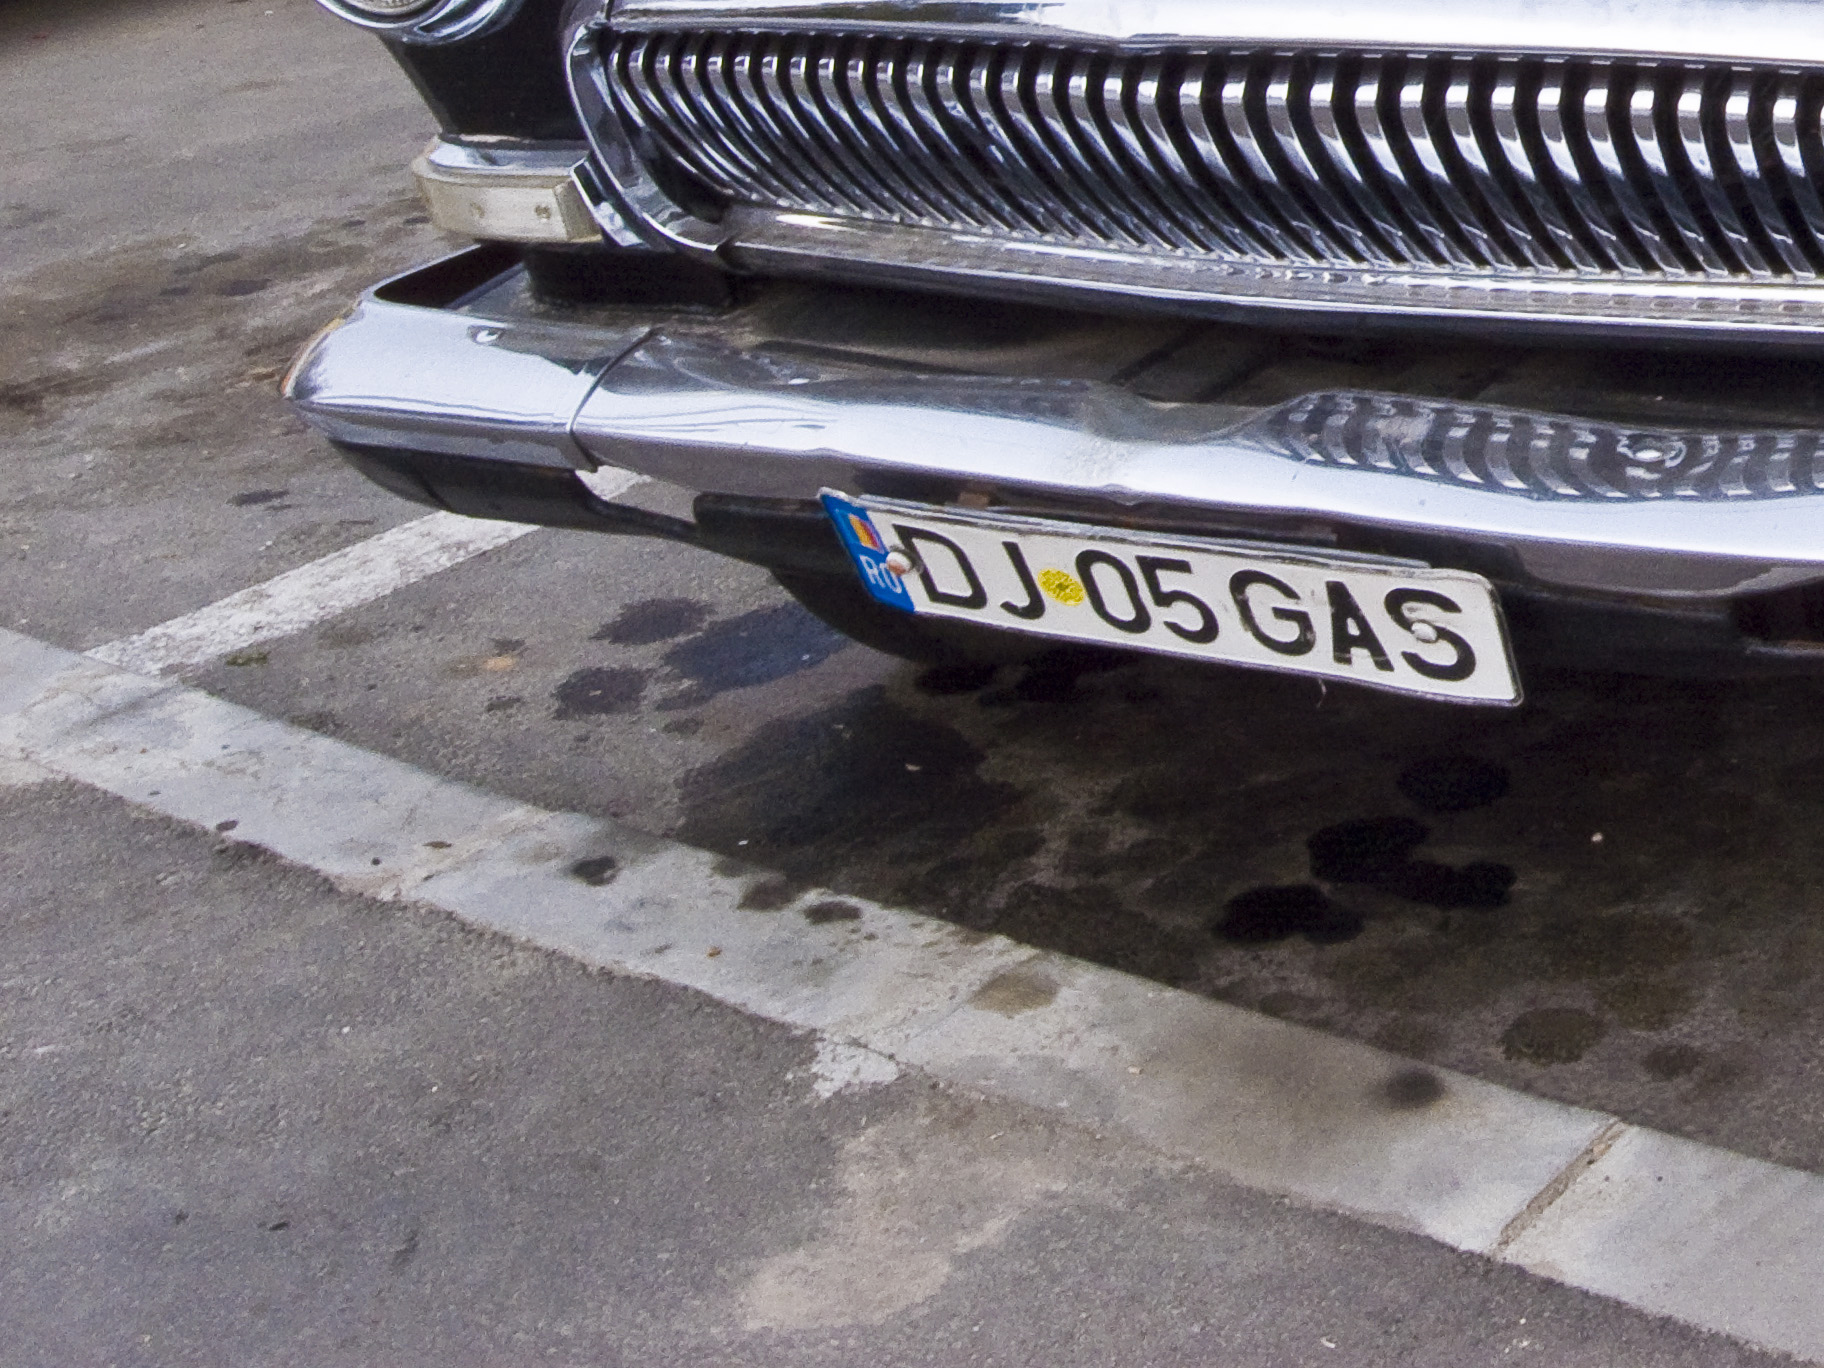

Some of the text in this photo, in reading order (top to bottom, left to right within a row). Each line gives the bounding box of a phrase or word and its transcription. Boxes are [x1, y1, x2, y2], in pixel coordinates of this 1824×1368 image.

[891, 523, 1476, 682] DJ 05 GAS
